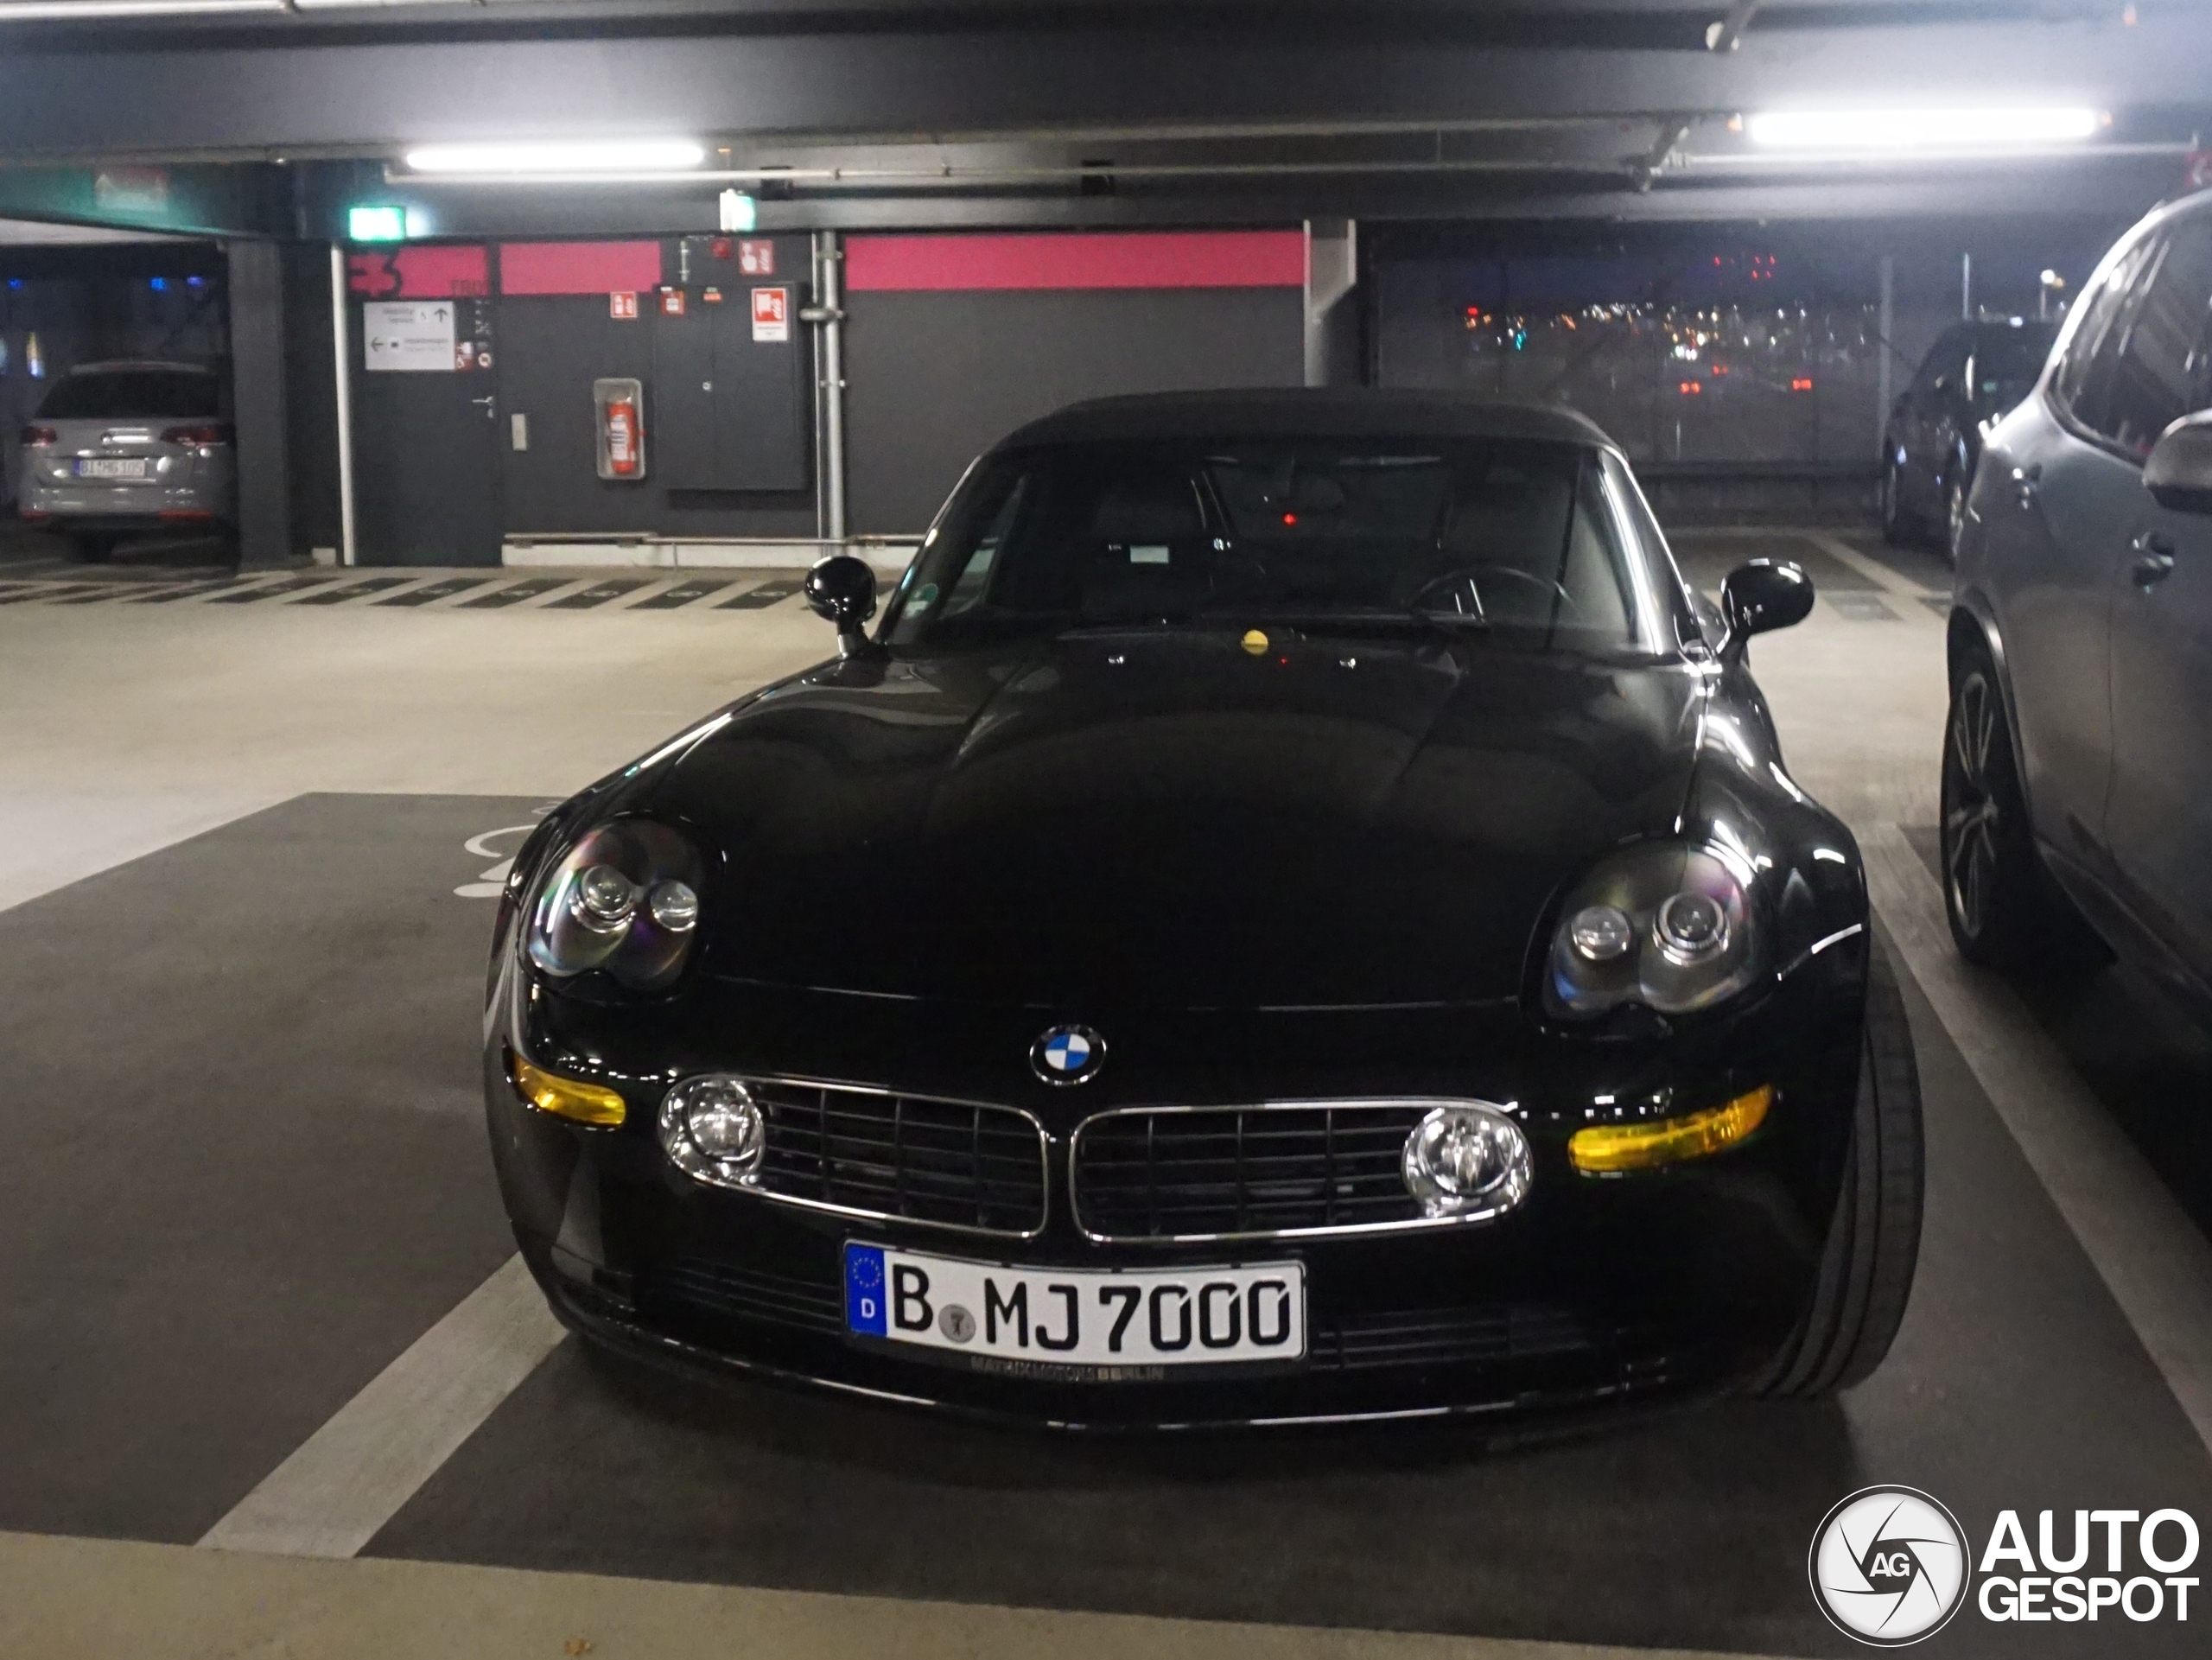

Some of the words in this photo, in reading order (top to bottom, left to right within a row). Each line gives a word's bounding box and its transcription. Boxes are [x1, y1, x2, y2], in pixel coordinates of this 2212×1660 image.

[861, 1299, 874, 1319] D
[893, 1264, 934, 1332] B
[984, 1278, 1079, 1352] MJ
[1098, 1280, 1290, 1352] 7000
